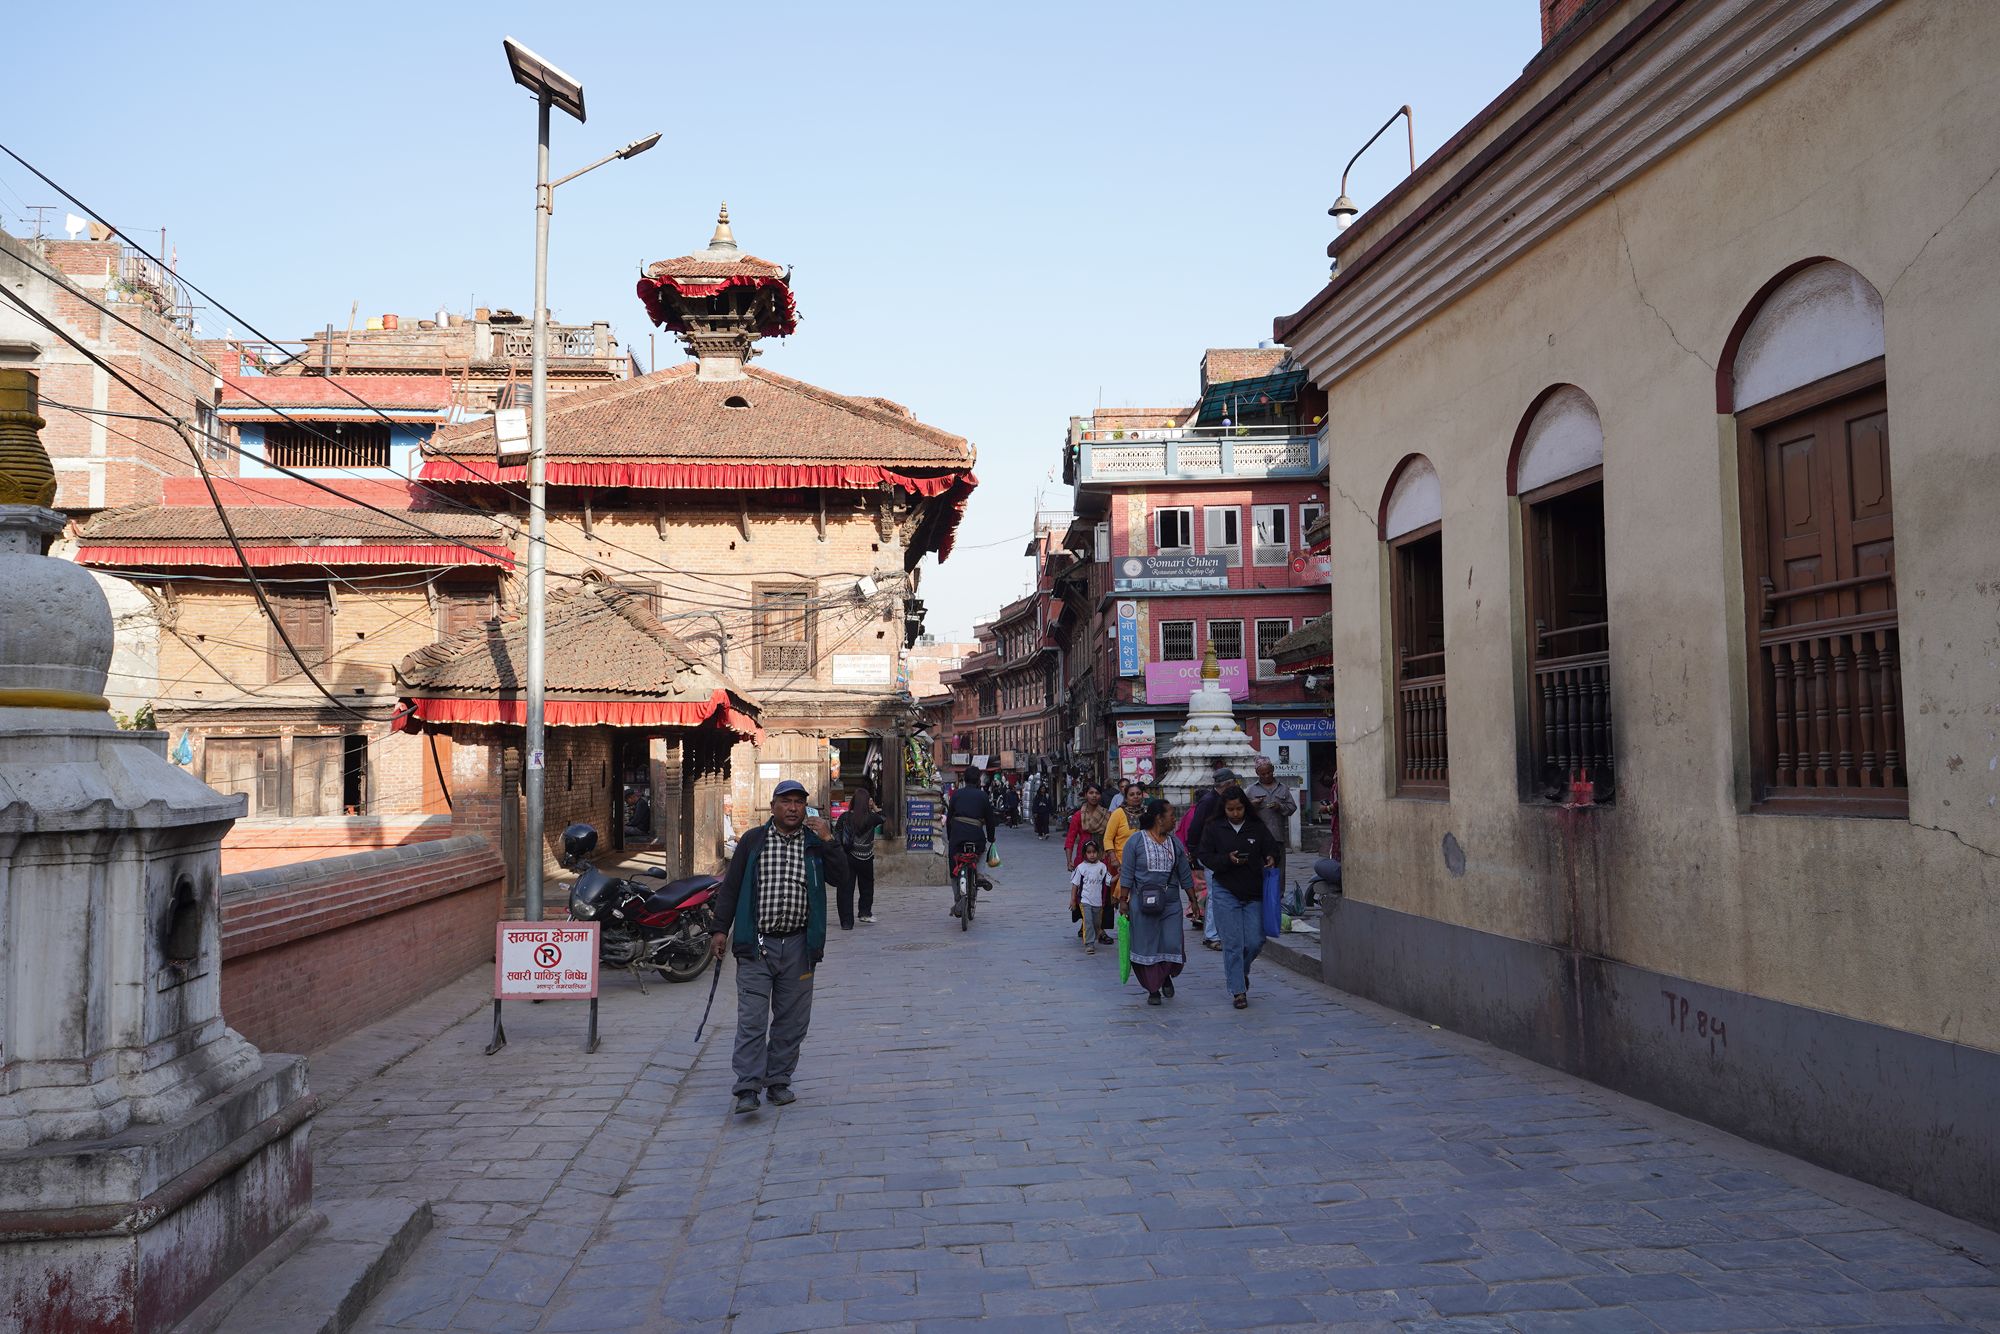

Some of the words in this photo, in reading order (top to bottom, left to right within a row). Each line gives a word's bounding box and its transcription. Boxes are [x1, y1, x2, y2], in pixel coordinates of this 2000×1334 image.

[1146, 556, 1185, 569] Gomari
[1187, 556, 1219, 567] Chhen
[1179, 665, 1240, 678] OCCONS
[1281, 720, 1316, 731] Gomari
[508, 931, 548, 944] सम्पदा
[552, 928, 589, 943] क्षेत्रमा
[507, 969, 532, 981] सवारी
[564, 969, 588, 981] निषेध
[1660, 990, 1689, 1033] TP
